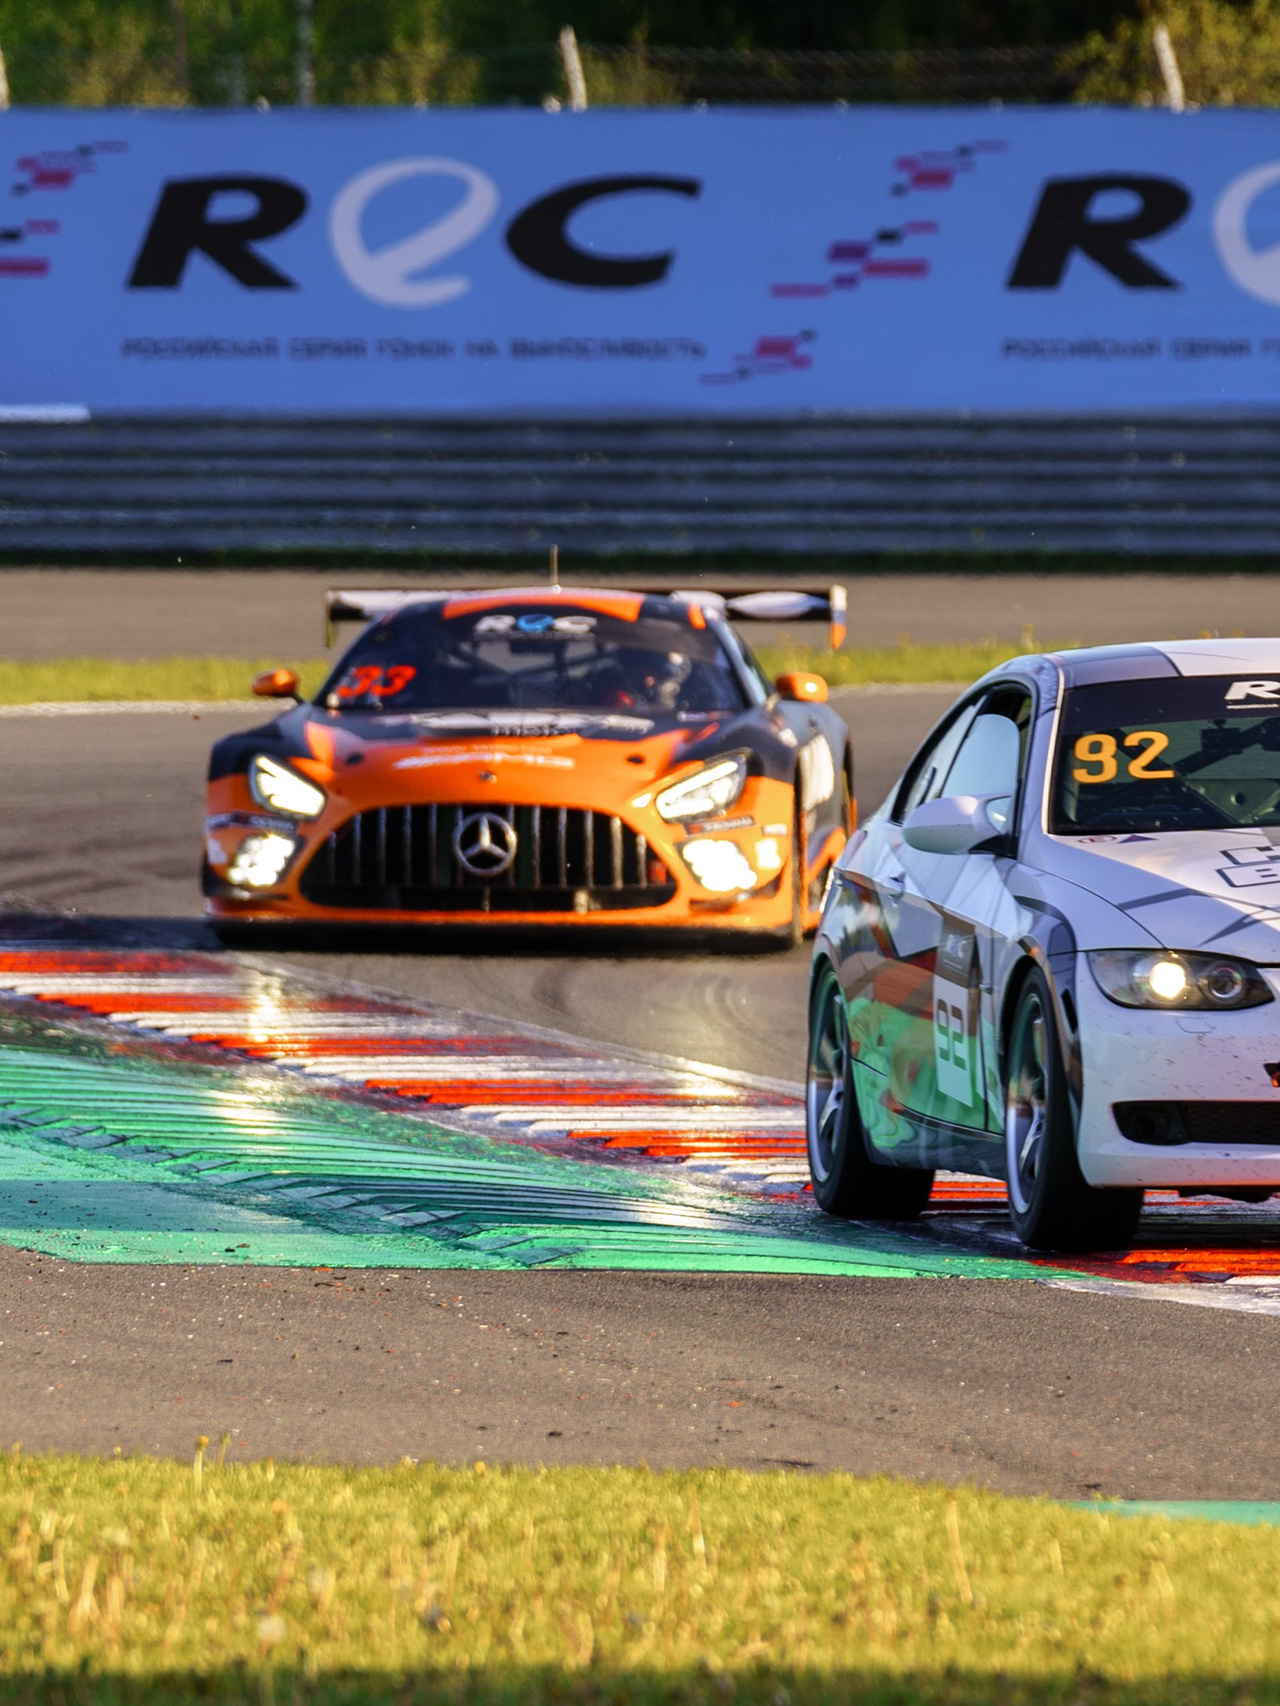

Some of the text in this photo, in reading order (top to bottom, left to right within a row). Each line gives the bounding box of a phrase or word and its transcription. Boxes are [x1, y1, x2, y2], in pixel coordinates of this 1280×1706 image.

[337, 665, 417, 697] 33
[1072, 730, 1176, 784] 92
[937, 999, 967, 1071] 92
